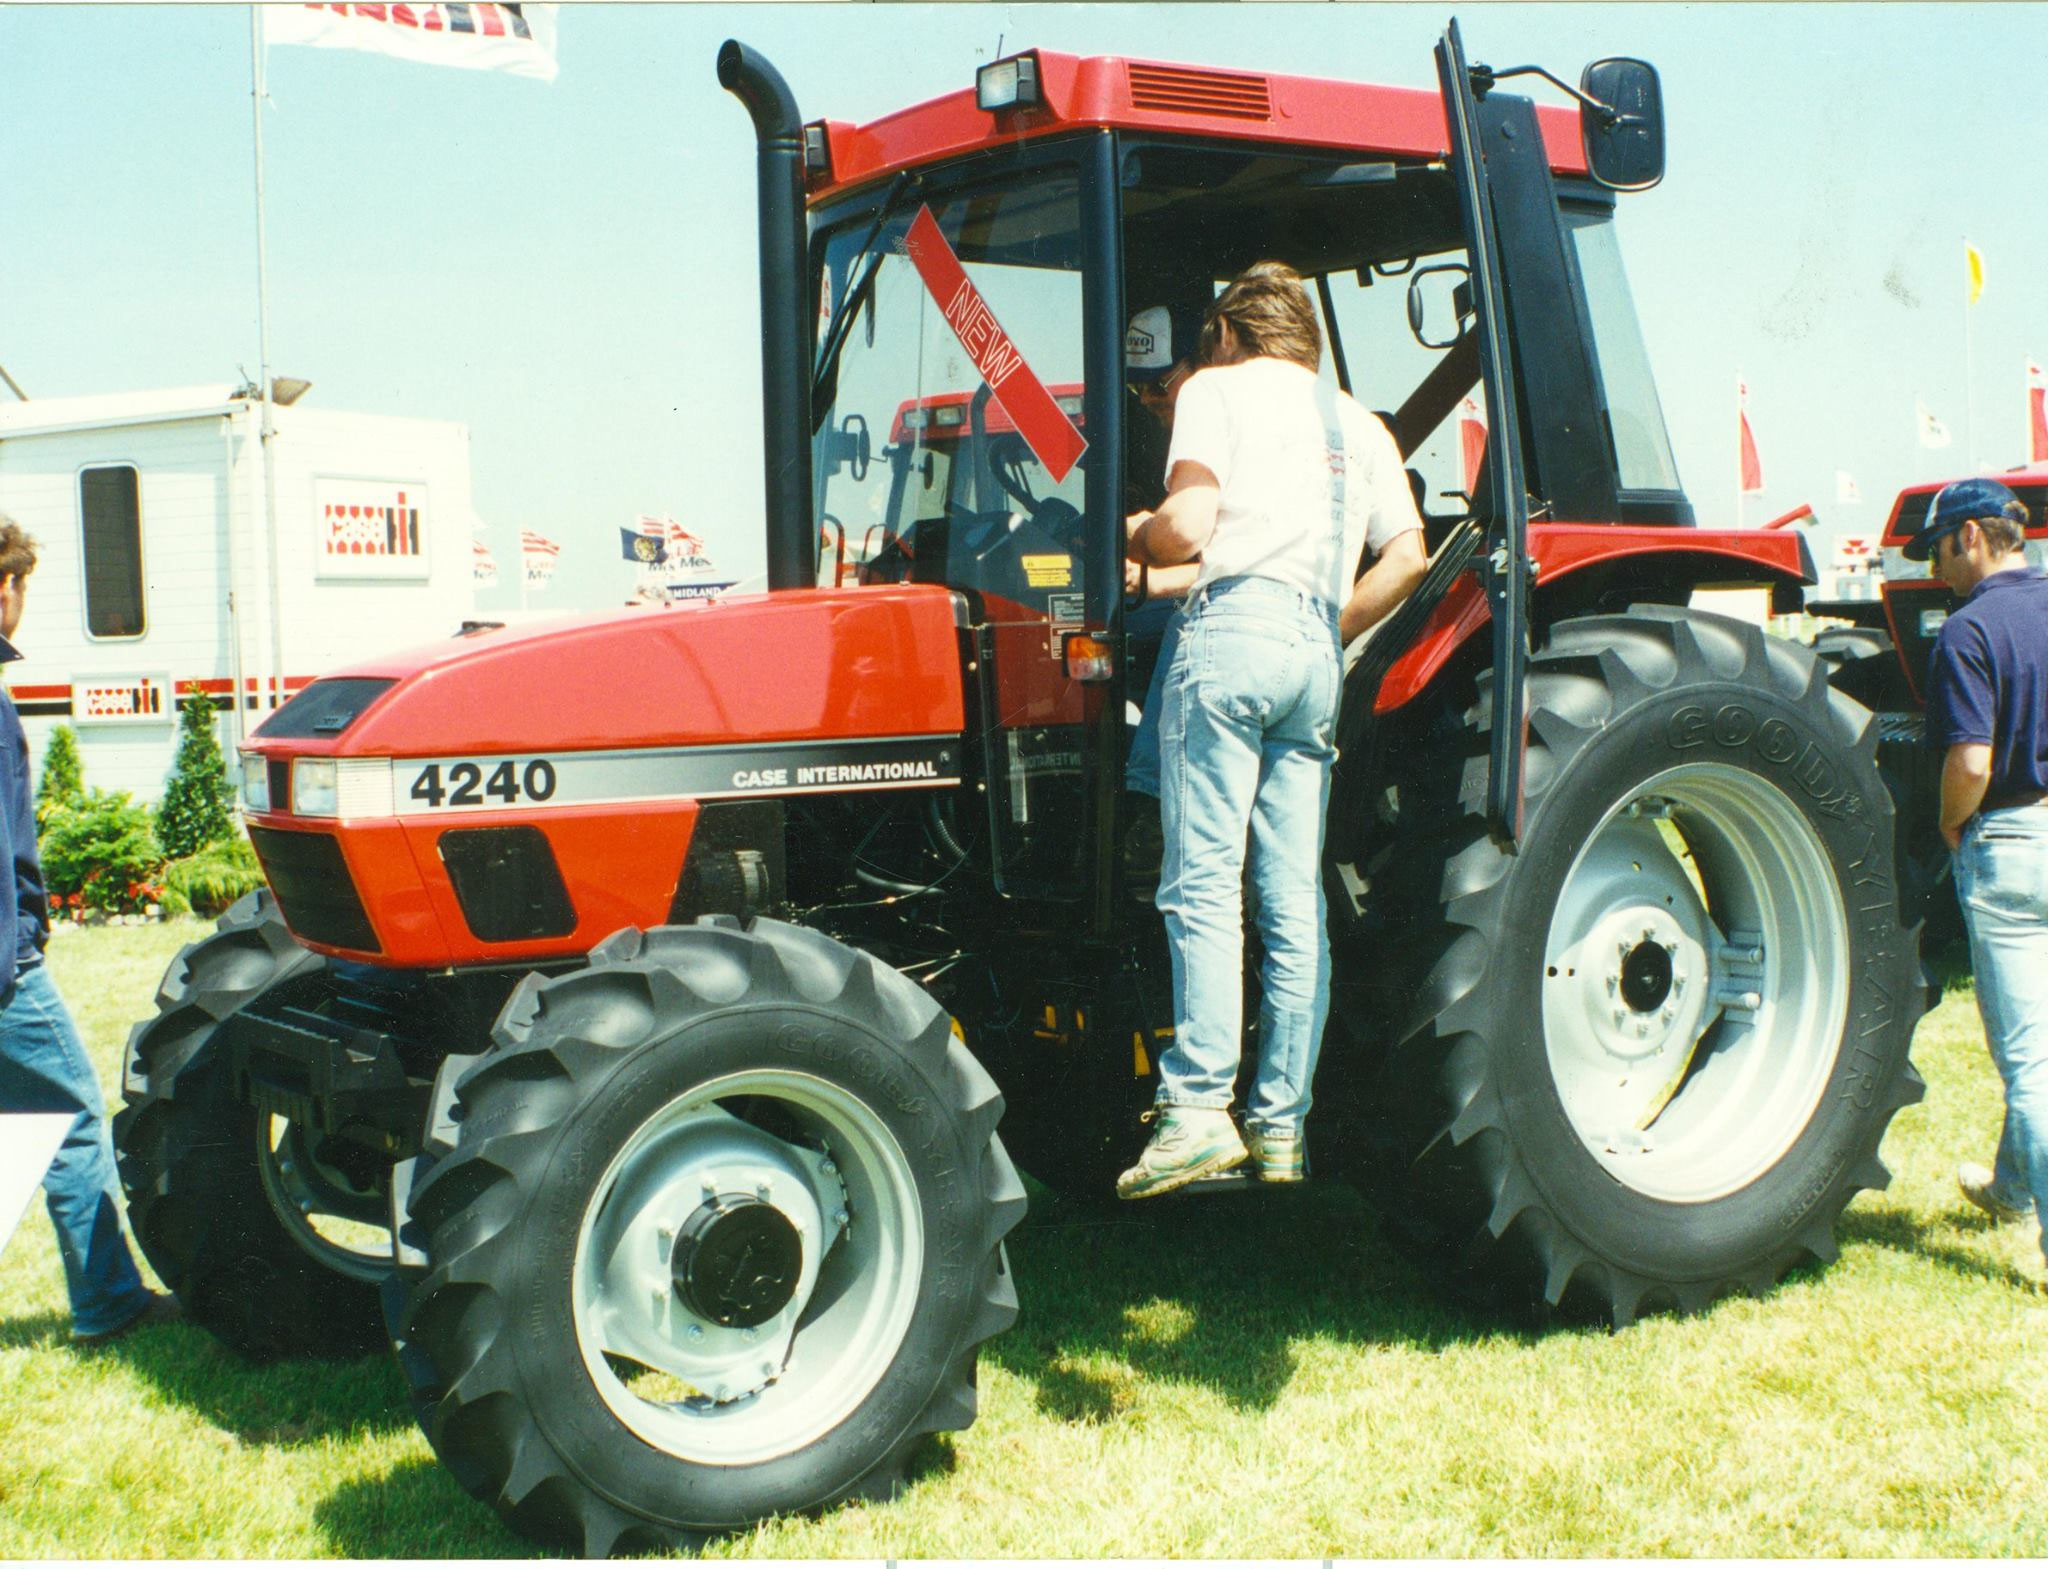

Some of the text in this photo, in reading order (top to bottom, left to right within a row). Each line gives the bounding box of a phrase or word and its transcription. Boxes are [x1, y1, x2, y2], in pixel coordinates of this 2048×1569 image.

[945, 277, 1022, 388] NEW
[411, 759, 557, 807] 4240
[732, 761, 938, 788] CASE INTERNATIONAL
